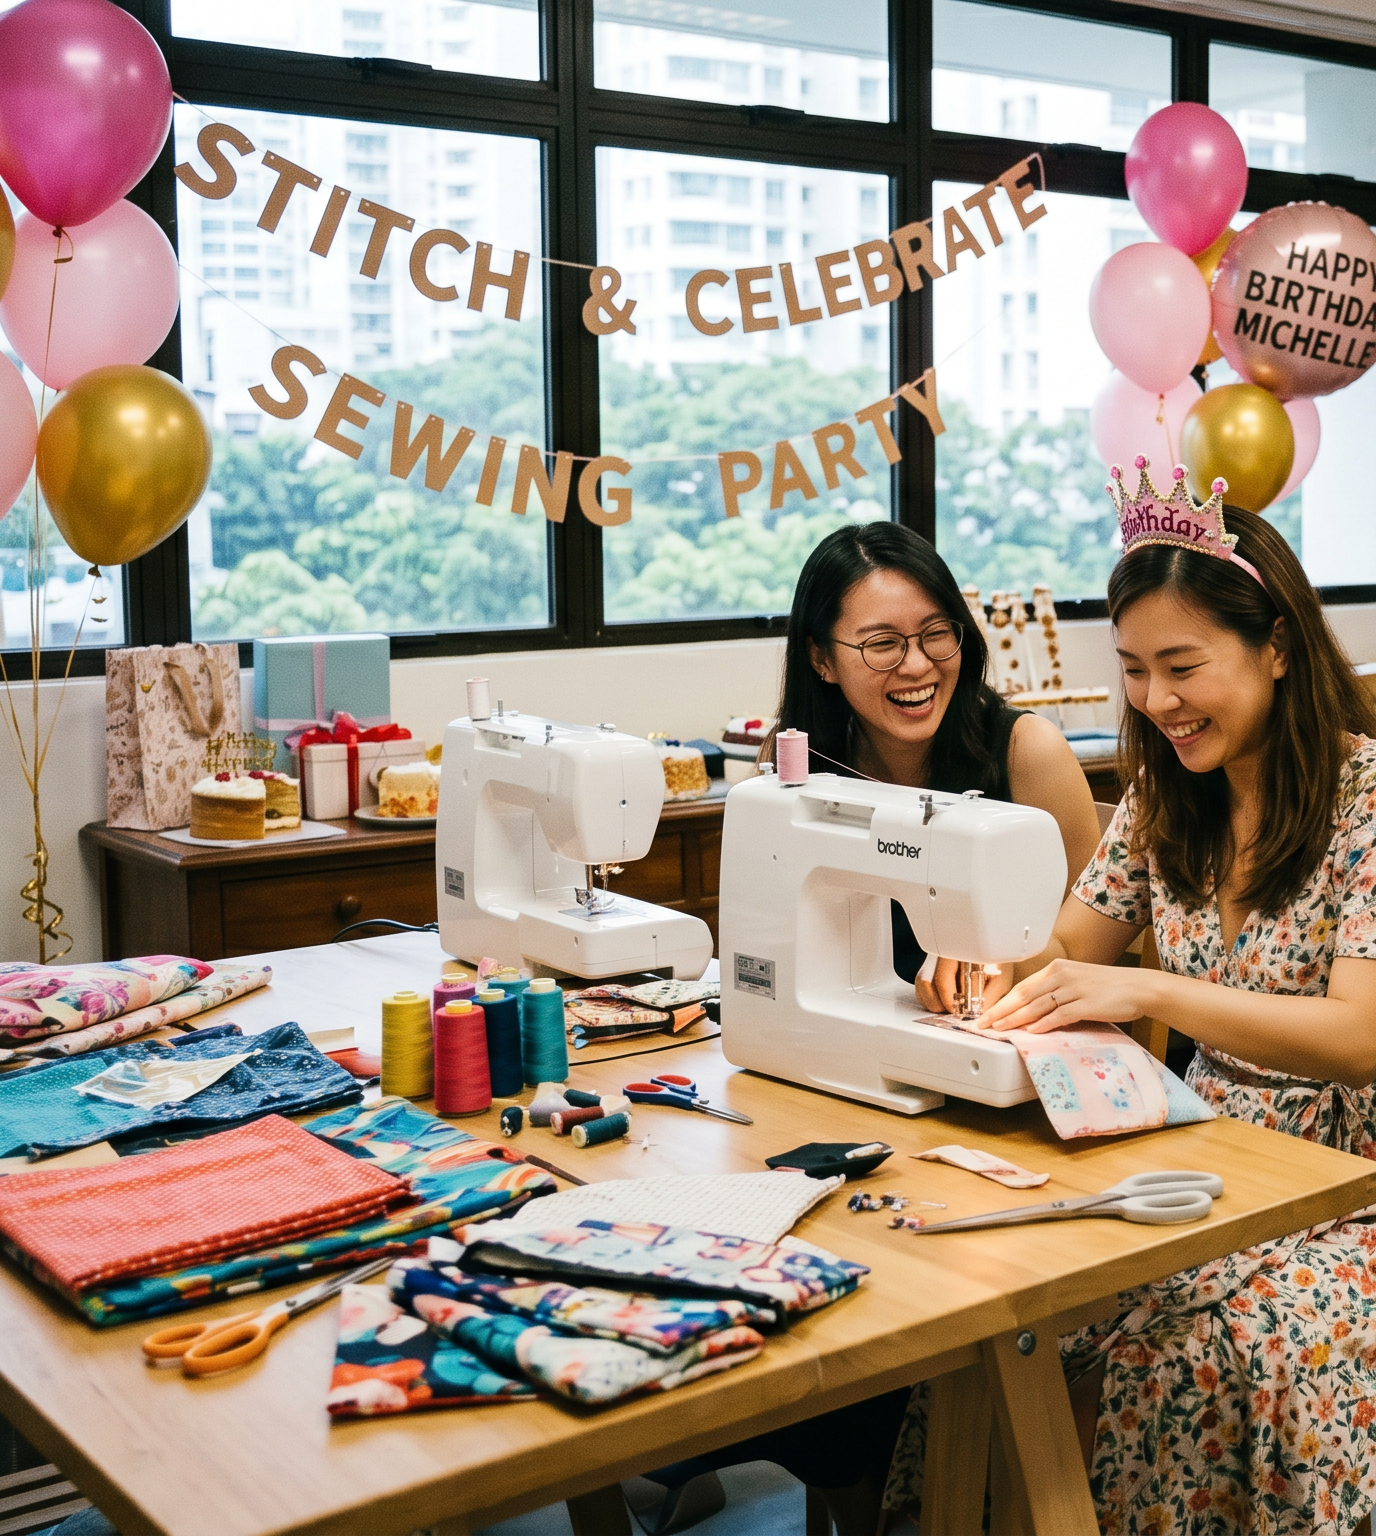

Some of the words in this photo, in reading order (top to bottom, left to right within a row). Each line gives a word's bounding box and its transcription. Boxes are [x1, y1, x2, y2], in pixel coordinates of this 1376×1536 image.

[174, 122, 530, 322] STITCH
[582, 266, 638, 337] &
[685, 159, 1048, 337] CELEBRATE
[1233, 308, 1376, 369] MICHELLE
[248, 344, 633, 527] SEWING
[718, 367, 947, 519] PARTY
[877, 838, 922, 859] brother
